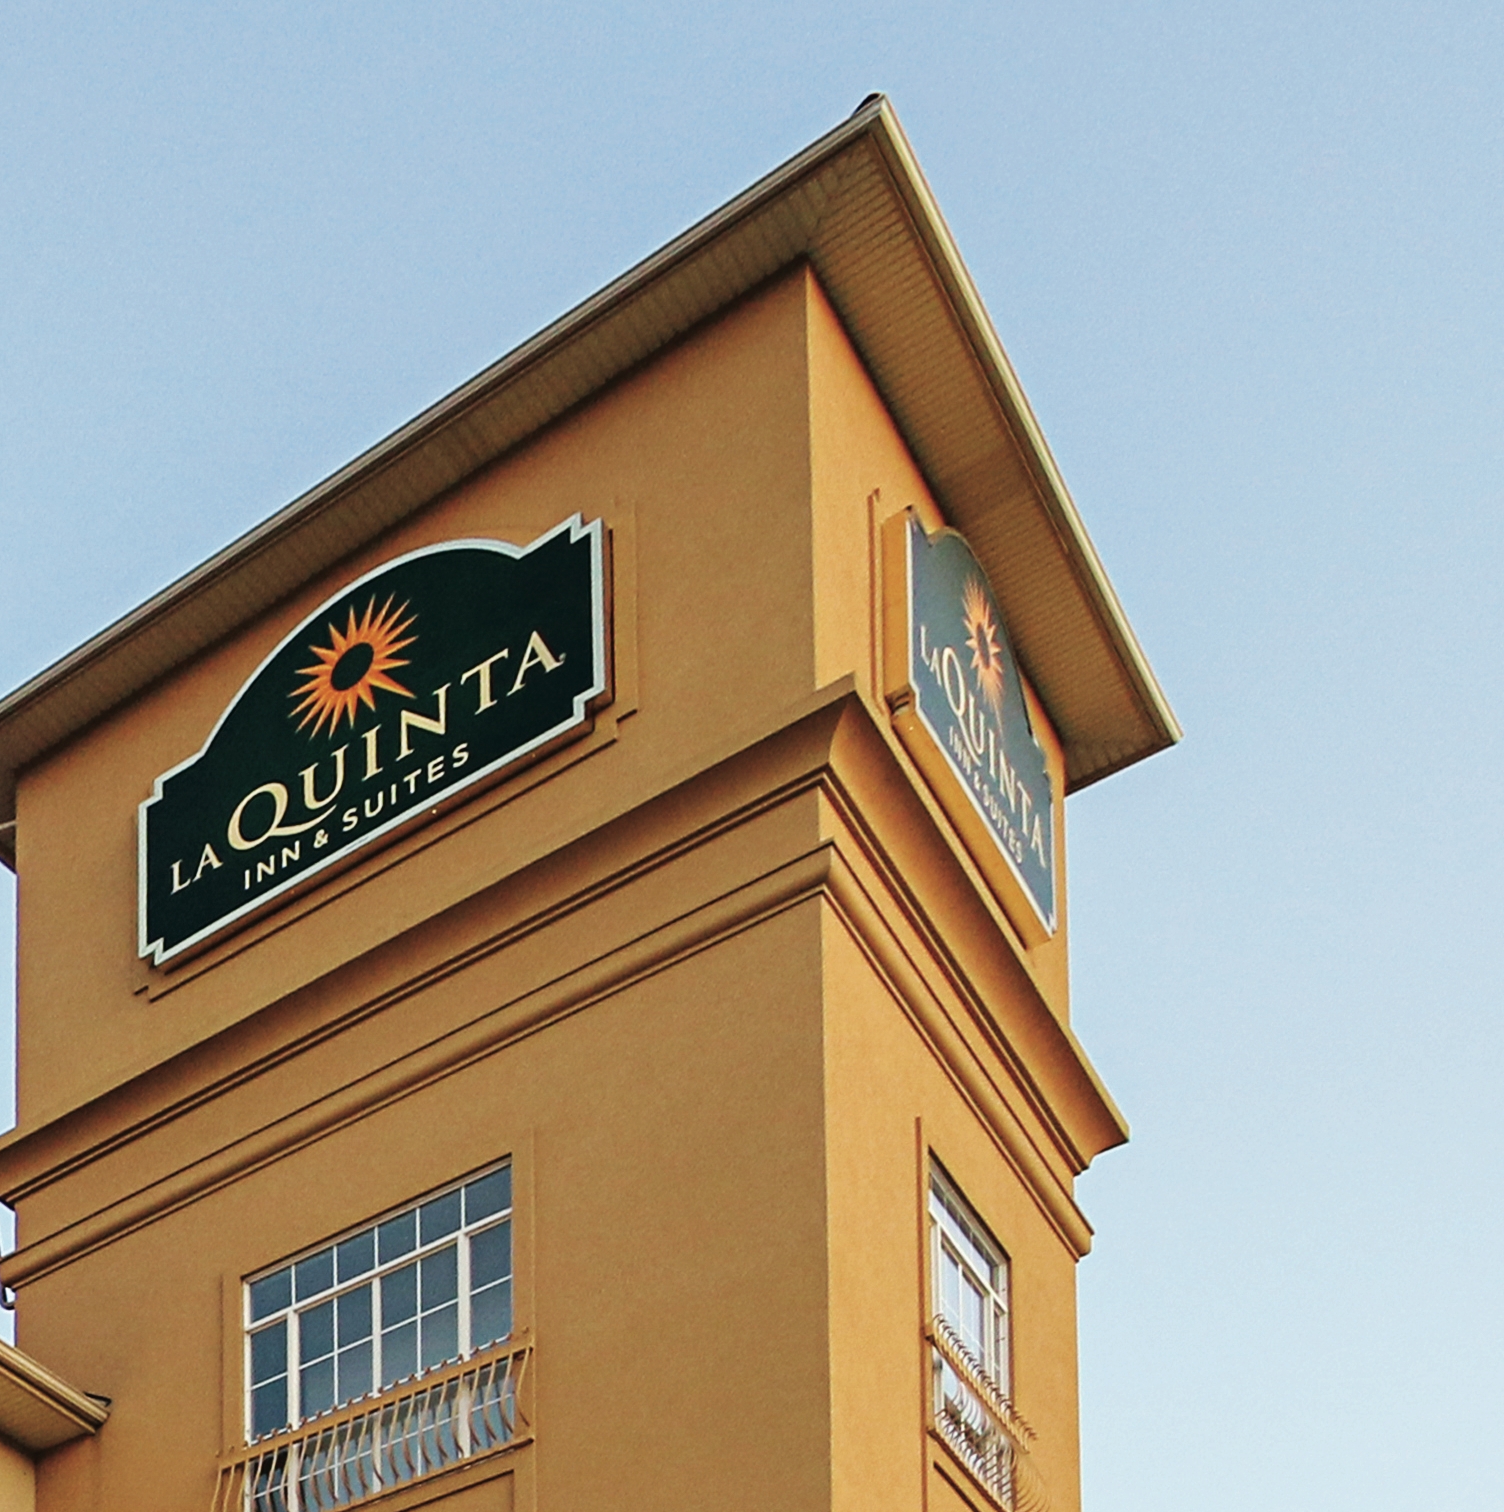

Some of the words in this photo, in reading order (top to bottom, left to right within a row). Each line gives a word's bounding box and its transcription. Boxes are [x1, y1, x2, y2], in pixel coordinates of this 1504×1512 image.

[170, 842, 224, 895] LA
[227, 630, 564, 851] QUINTA
[244, 839, 301, 890] INN
[313, 829, 329, 849] &
[342, 742, 470, 832] SUITES
[920, 624, 942, 687] LA
[942, 646, 1047, 869] QUINTA
